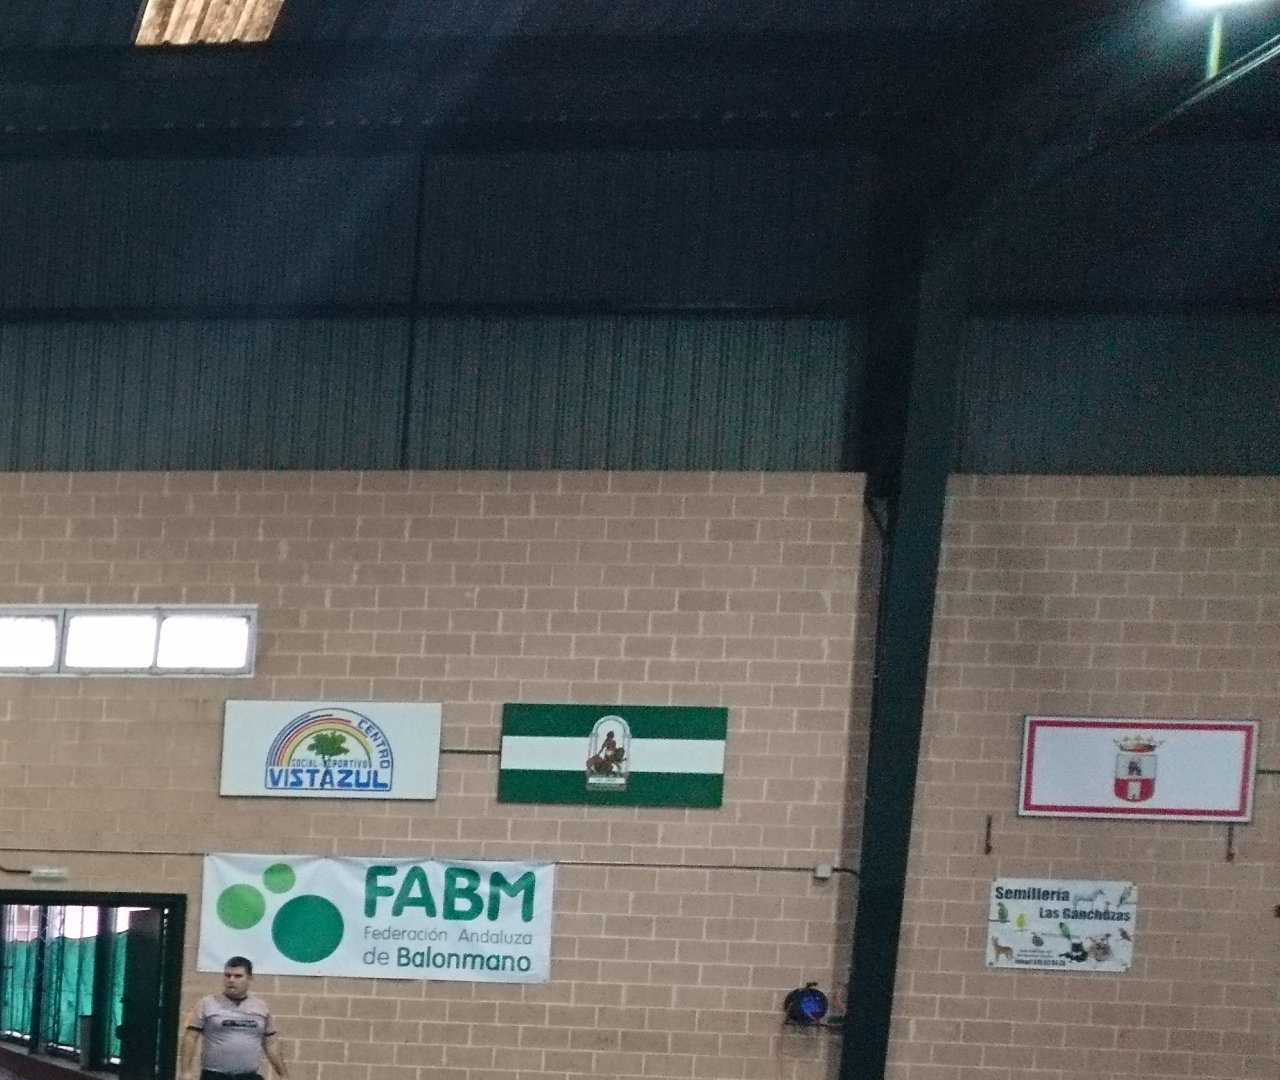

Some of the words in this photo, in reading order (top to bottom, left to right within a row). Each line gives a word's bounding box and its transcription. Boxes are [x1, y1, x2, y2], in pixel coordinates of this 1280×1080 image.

[356, 719, 390, 769] CENTRO
[269, 768, 389, 789] VISTAZUL
[364, 865, 536, 923] FABM
[1039, 907, 1060, 919] Las
[364, 924, 448, 943] Federación
[458, 928, 533, 946] Andaluza
[362, 946, 390, 967] de
[397, 946, 532, 973] Balonmano
